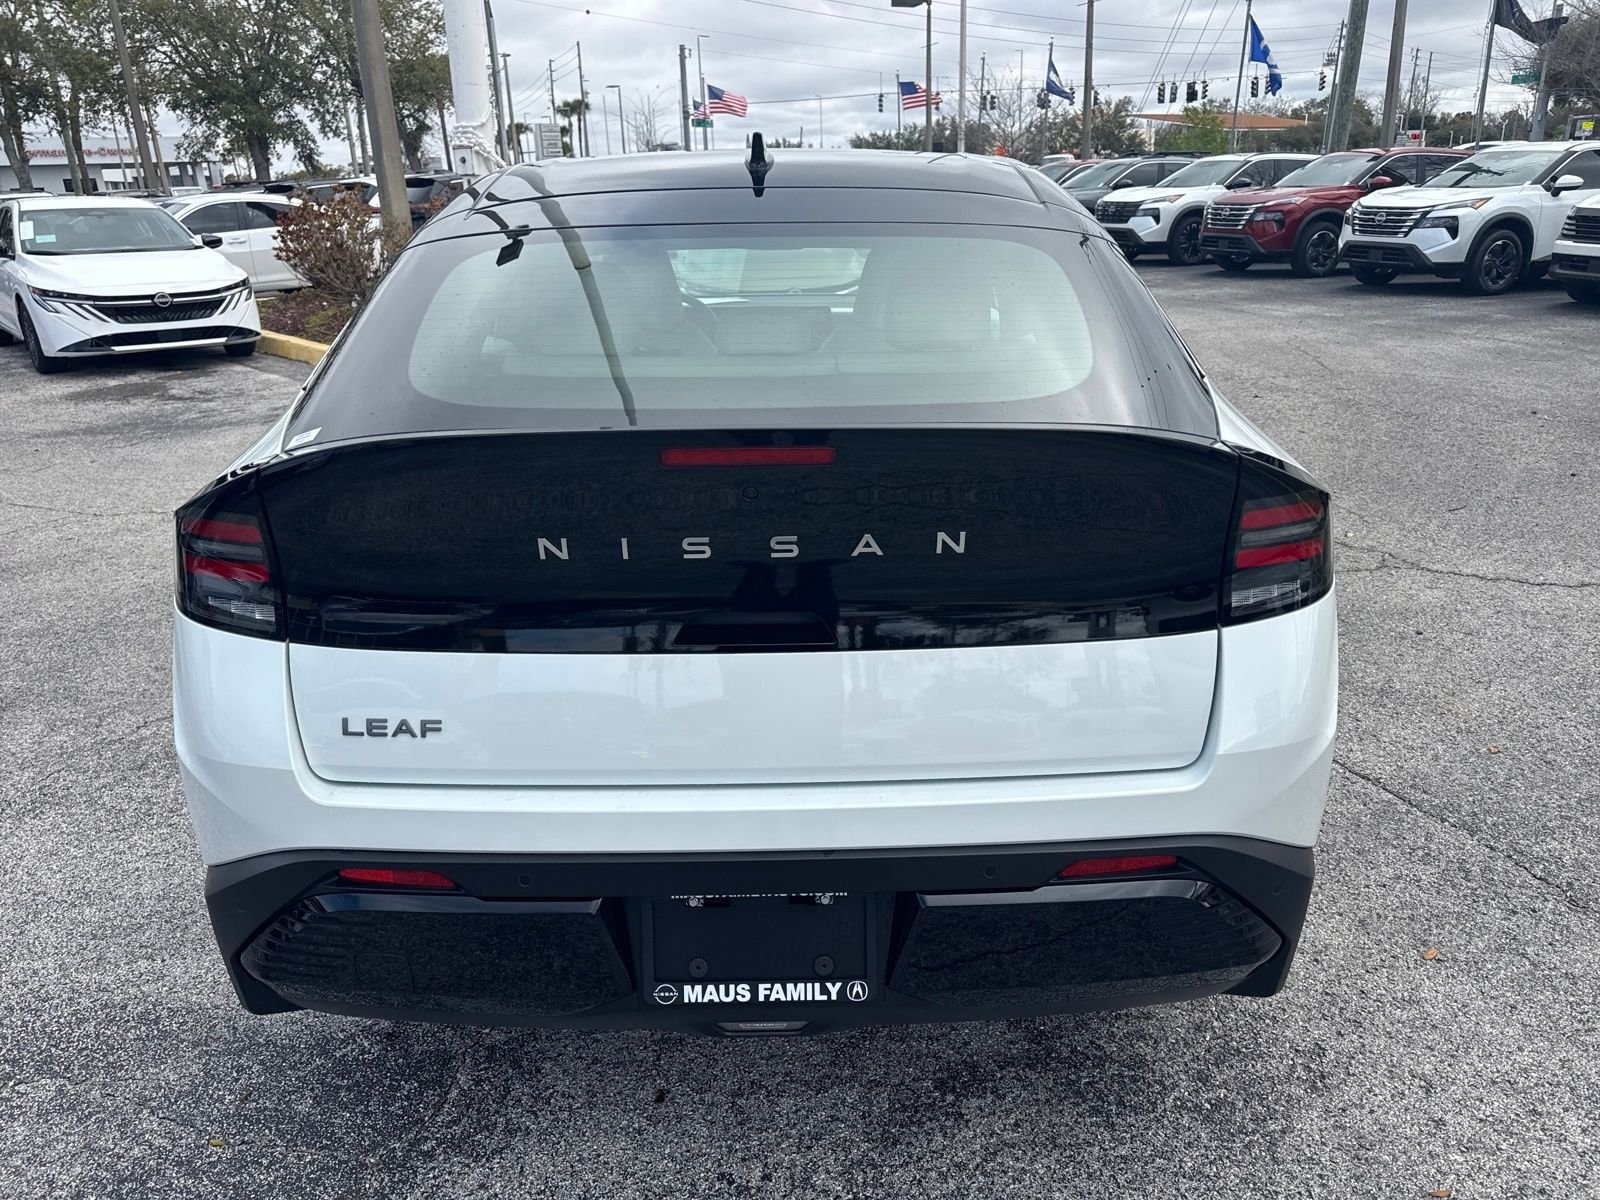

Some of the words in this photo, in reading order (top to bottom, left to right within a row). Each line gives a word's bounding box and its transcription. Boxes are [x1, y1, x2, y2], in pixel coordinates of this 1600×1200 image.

[537, 531, 967, 560] NISSAN
[341, 717, 443, 738] LEAF
[683, 984, 751, 1003] MAUS
[758, 982, 842, 1001] FAMILY
